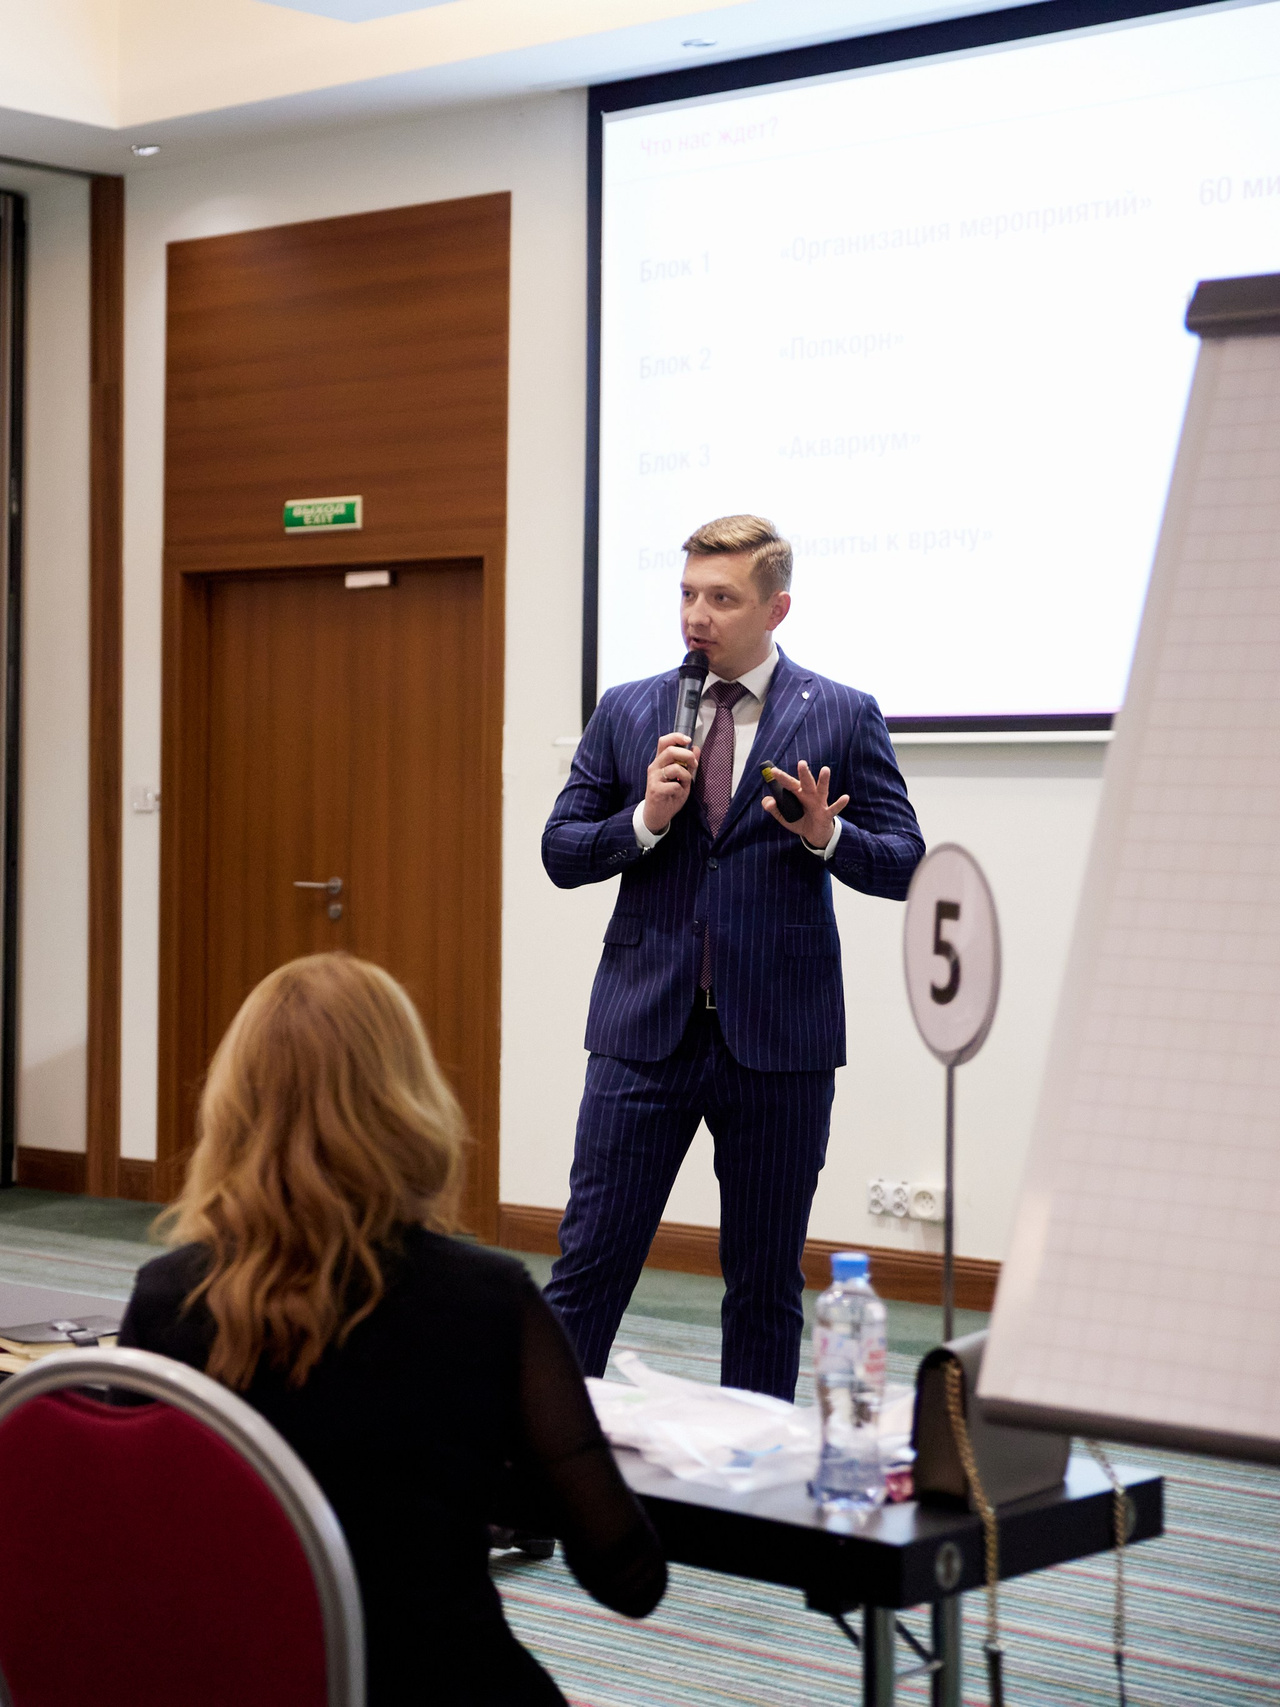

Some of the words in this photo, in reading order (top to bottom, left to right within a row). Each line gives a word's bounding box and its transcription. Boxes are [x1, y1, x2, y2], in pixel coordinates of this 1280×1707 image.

[640, 258, 692, 283] Блок
[701, 251, 710, 273] 1
[1199, 175, 1233, 206] 60
[639, 354, 692, 380] Блок
[699, 346, 712, 371] 2
[638, 450, 691, 476] Блок
[698, 443, 711, 468] 3
[638, 546, 681, 571] Бло
[886, 532, 899, 551] к
[930, 900, 962, 1006] 5
